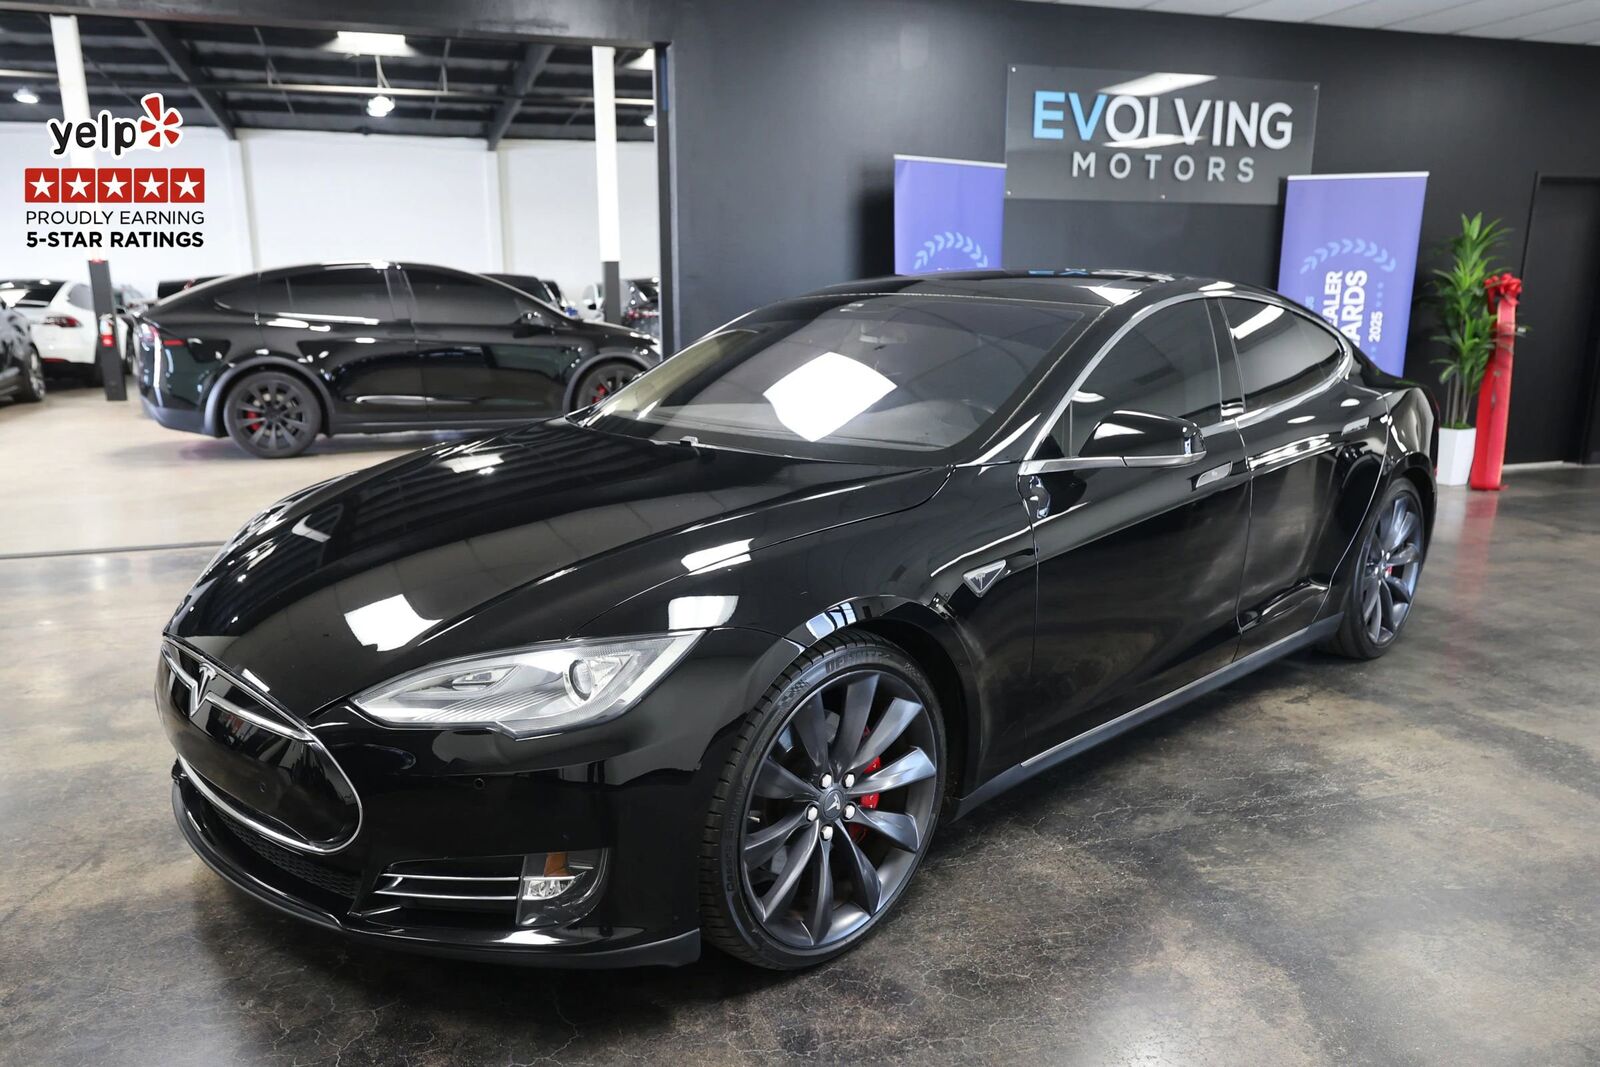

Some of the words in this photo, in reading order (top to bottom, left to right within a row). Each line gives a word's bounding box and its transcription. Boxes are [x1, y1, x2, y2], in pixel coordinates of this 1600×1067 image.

[1033, 90, 1294, 150] EVOLVING
[1072, 151, 1254, 182] MOTORS
[1340, 270, 1368, 348] ARDS
[1368, 311, 1383, 342] 2025
